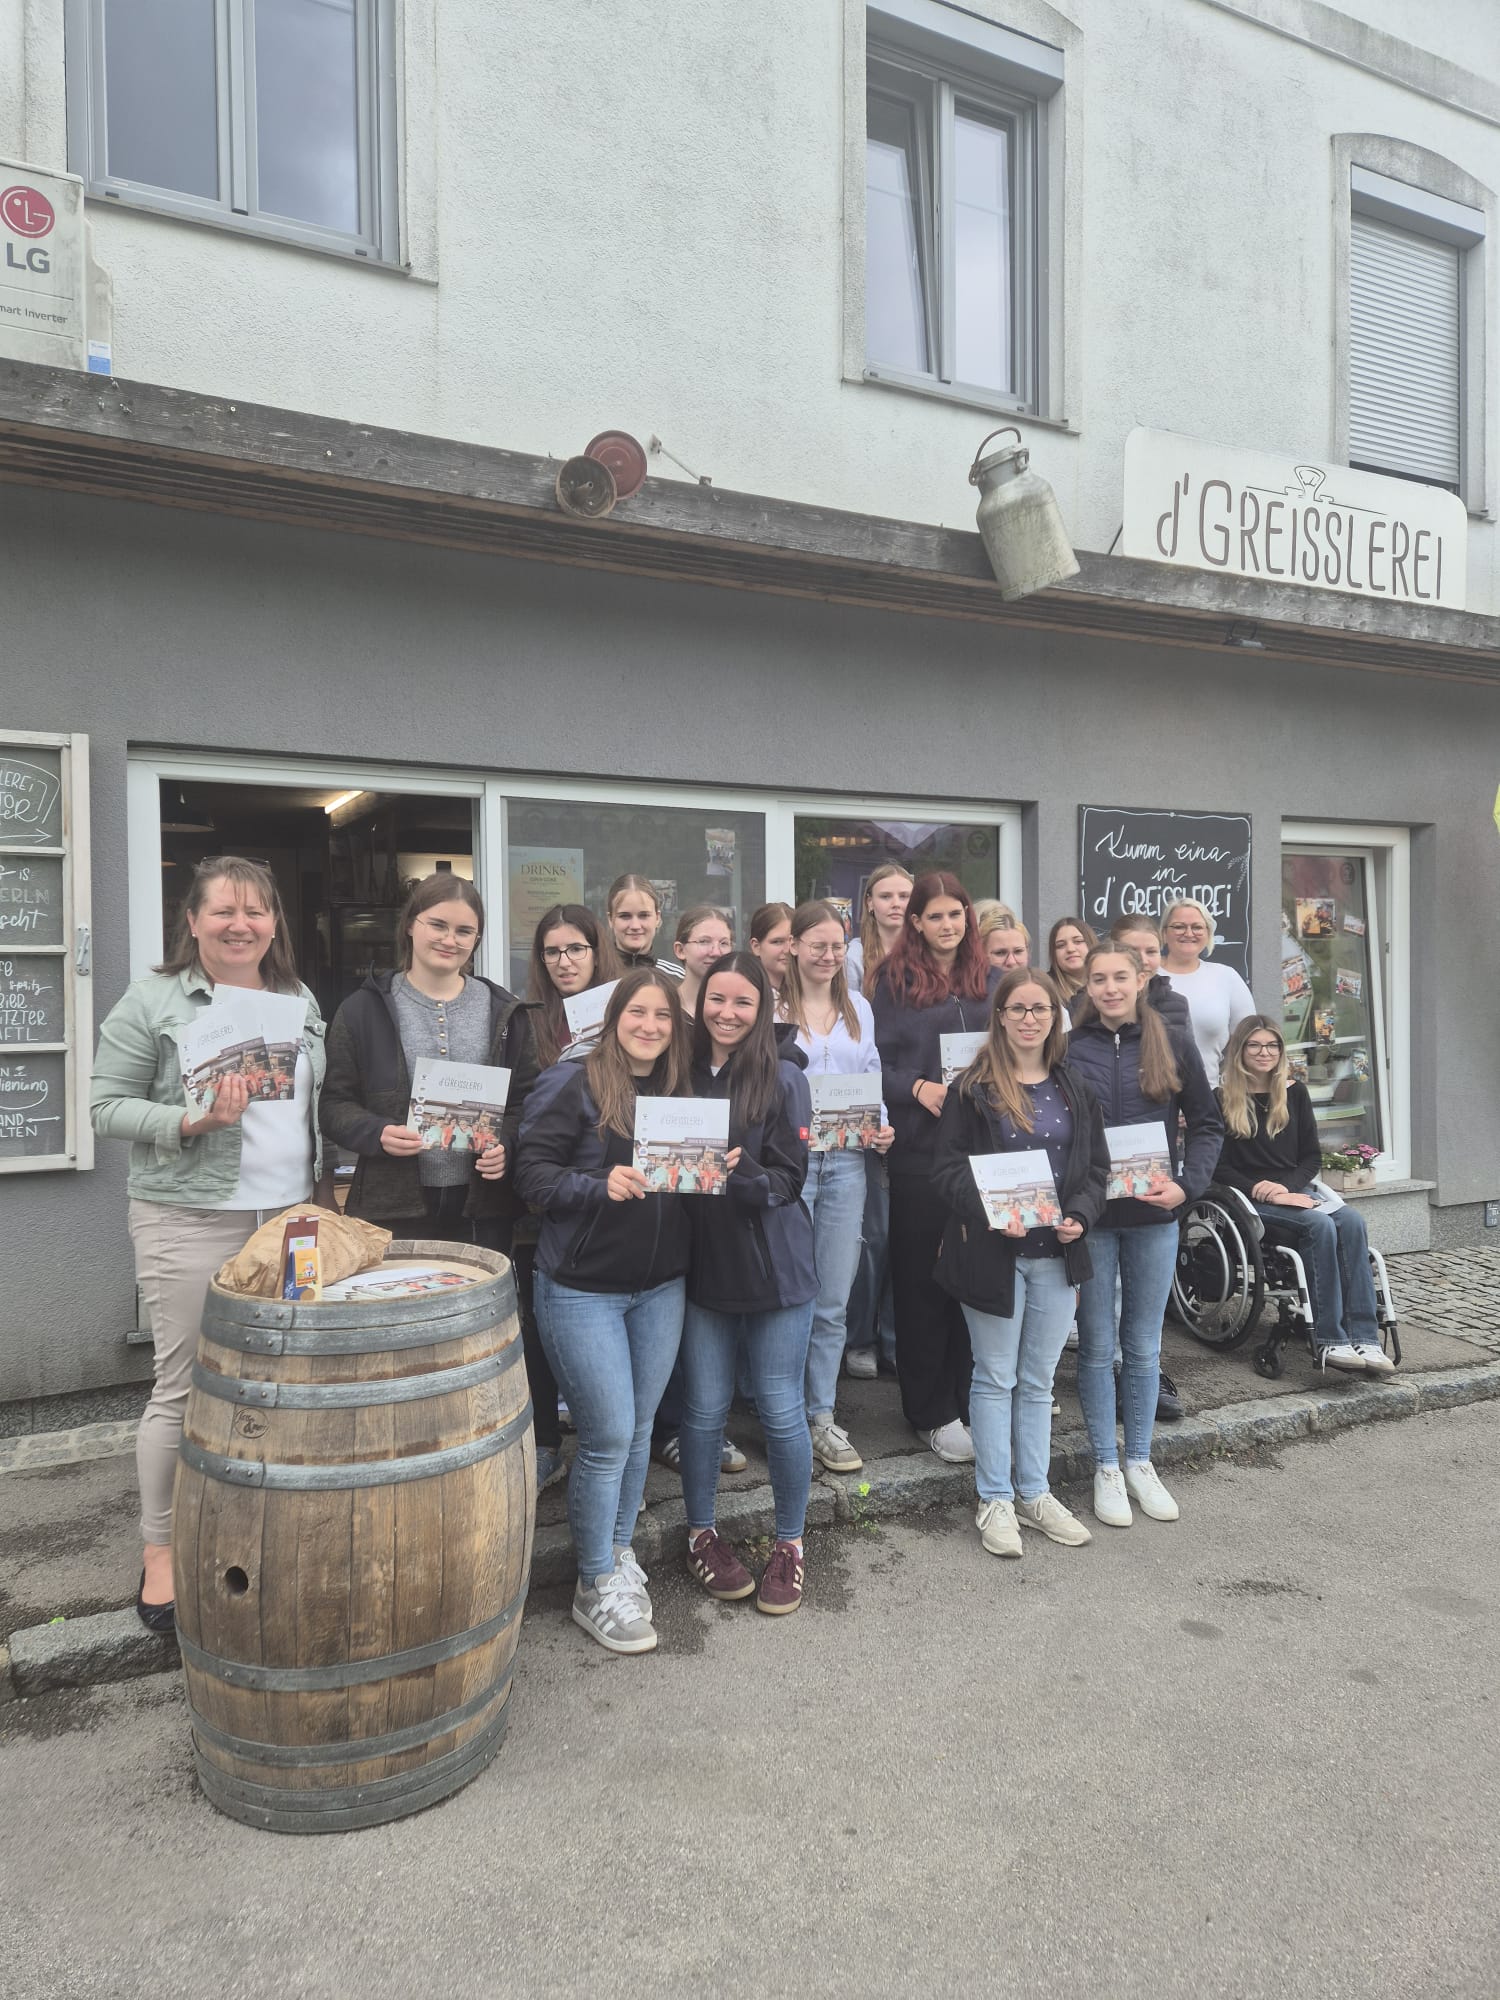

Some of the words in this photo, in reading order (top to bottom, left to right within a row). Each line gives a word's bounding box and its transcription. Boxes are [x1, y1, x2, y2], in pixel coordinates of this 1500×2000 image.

[7, 242, 50, 274] LG
[25, 307, 68, 323] Inverter
[1095, 825, 1165, 861] Kumm
[521, 864, 566, 876] DRINKS
[1151, 866, 1187, 882] in
